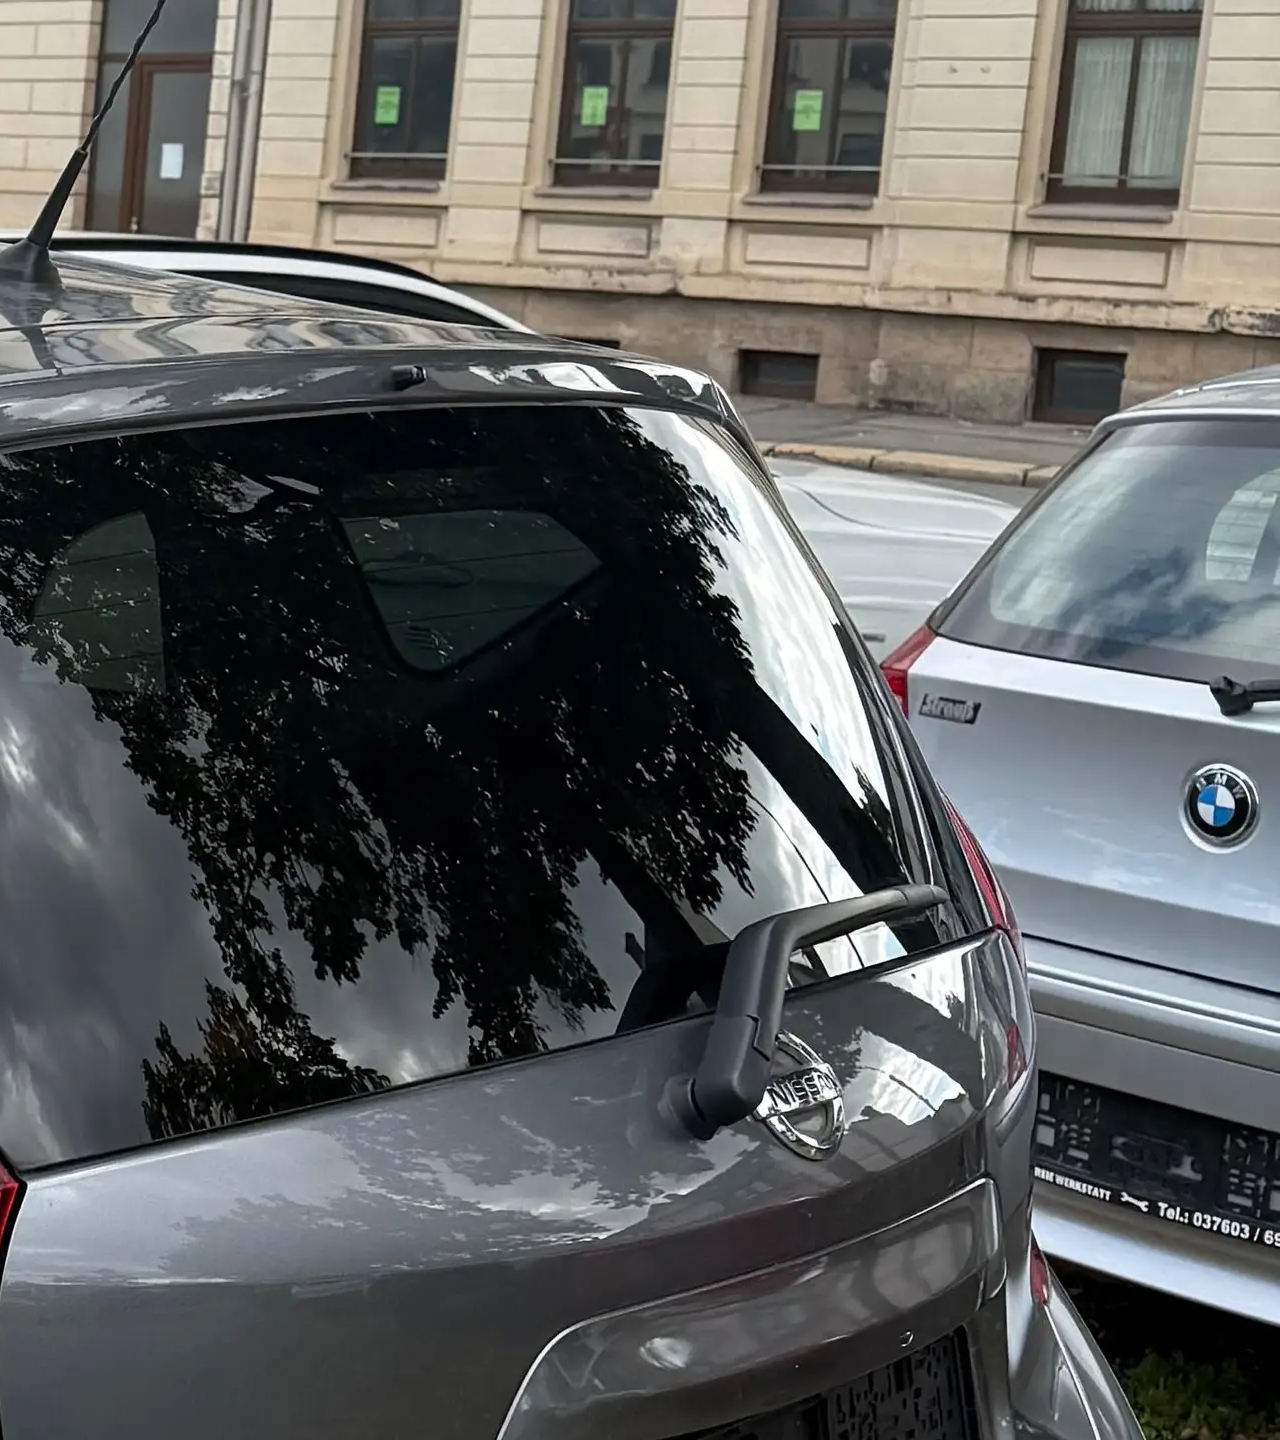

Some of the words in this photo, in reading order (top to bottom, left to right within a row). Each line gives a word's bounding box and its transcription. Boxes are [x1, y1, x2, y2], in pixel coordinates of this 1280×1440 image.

[1195, 772, 1246, 800] BMW
[1055, 1173, 1112, 1201] WERKSTATT
[1157, 1201, 1189, 1224] Tel.:
[1193, 1211, 1251, 1240] 037603
